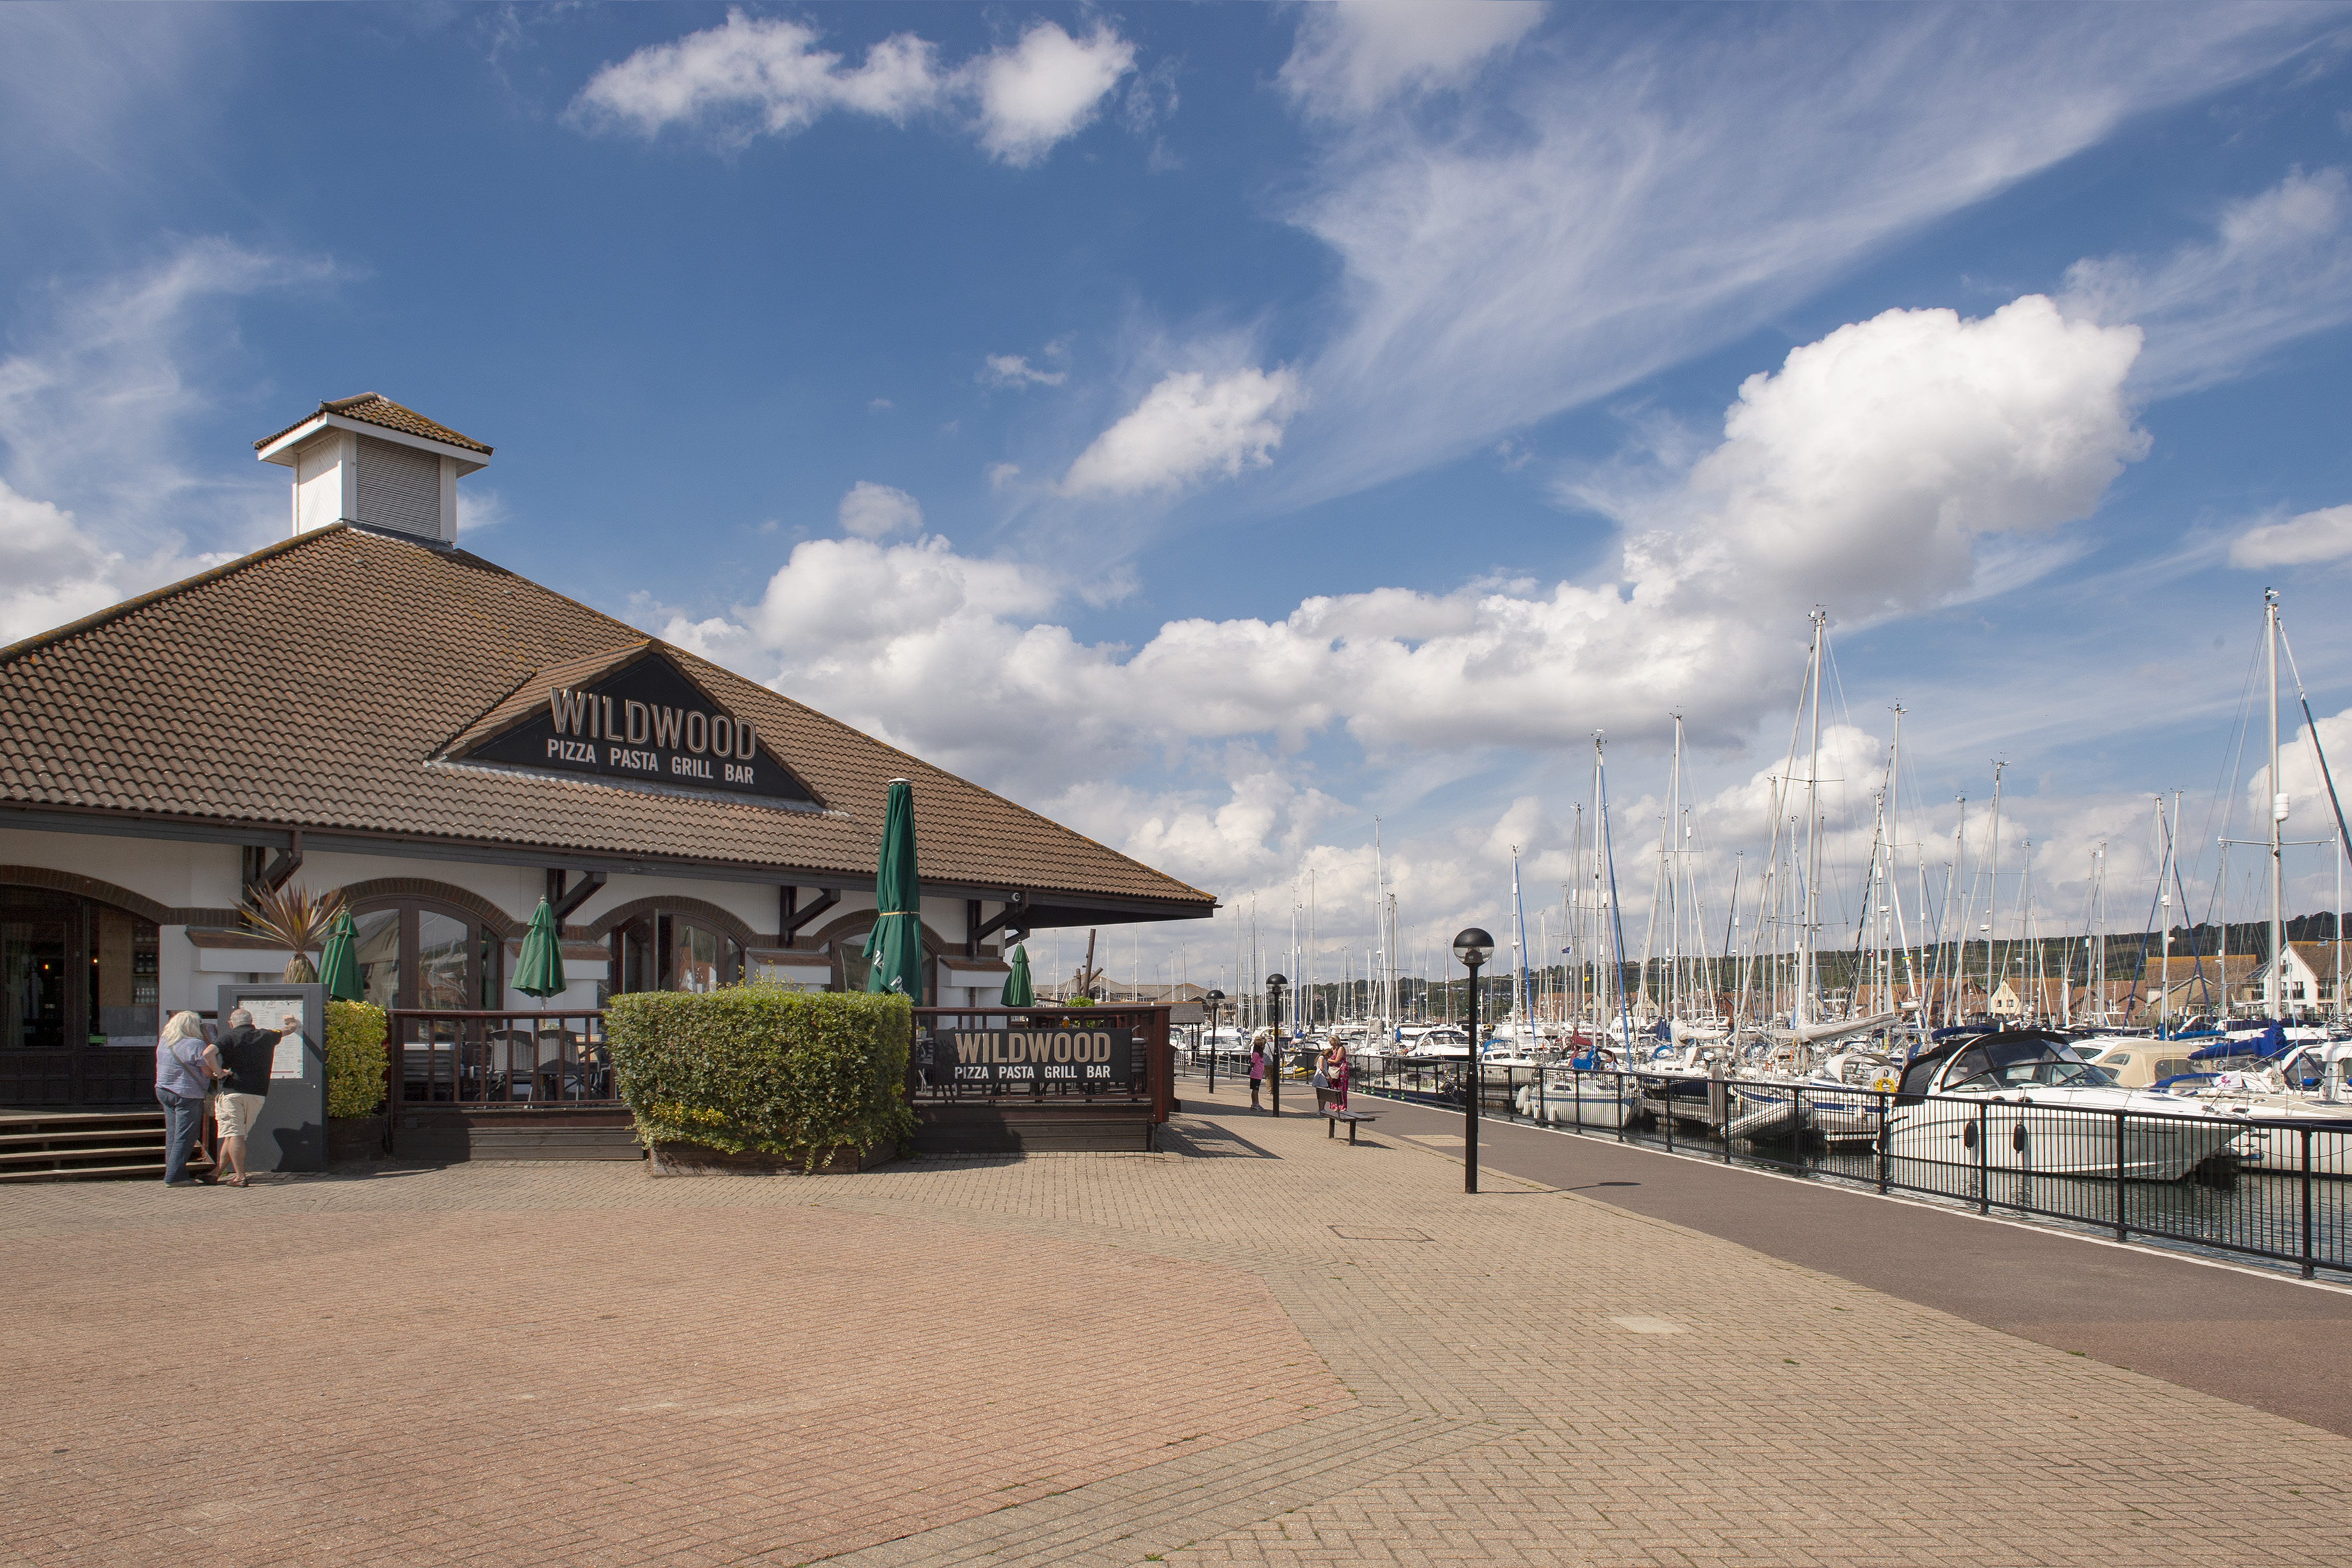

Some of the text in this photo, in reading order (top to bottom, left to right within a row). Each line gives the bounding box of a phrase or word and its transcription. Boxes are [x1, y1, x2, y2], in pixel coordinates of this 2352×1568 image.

[550, 686, 756, 760] WILDWOOD
[547, 738, 754, 785] PIZZA PASTA GRILL BAR
[955, 1032, 1111, 1063] WILDWOOD
[955, 1065, 1111, 1079] PIZZA PASTA GRILL BAR
